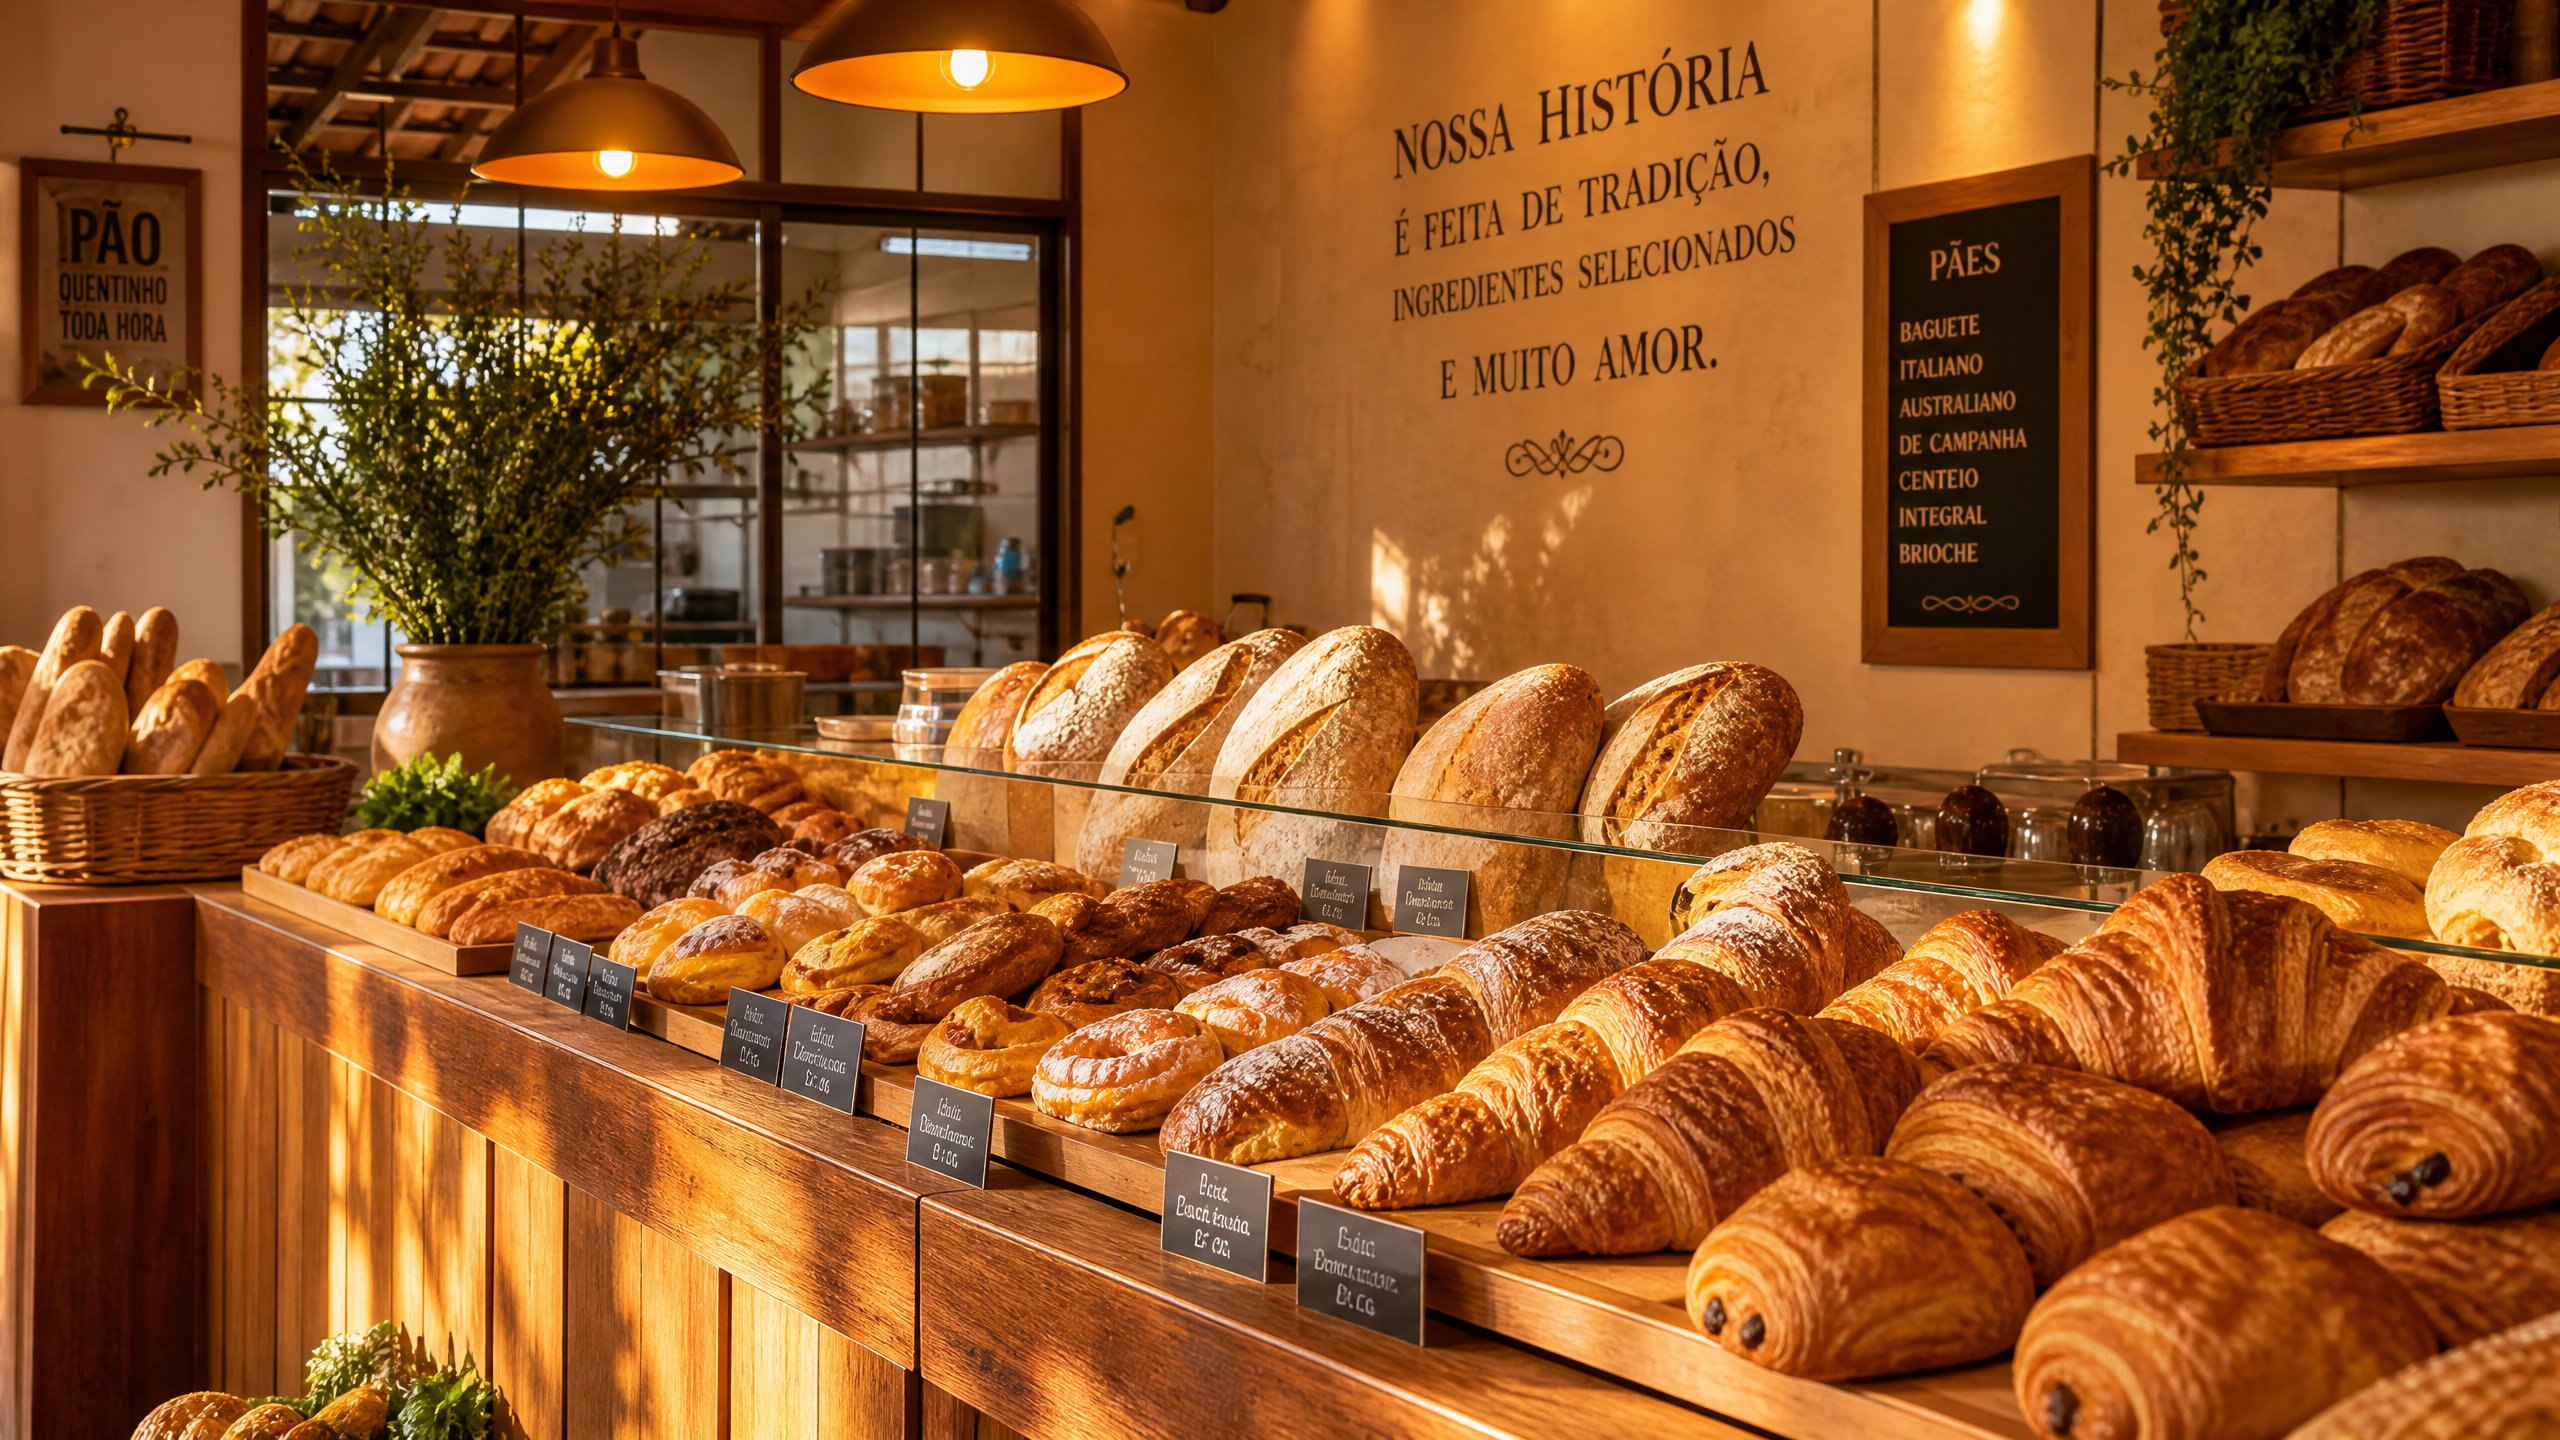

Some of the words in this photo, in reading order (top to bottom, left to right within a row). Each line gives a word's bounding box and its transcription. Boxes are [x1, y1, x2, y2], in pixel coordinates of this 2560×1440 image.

[1393, 103, 1515, 180] NOSSA
[1538, 40, 1770, 145] HISTÓRIA
[1394, 208, 1410, 257] É
[1424, 199, 1505, 251] FEITA
[1521, 185, 1564, 231] DE
[1579, 137, 1770, 218] TRADIÇÃO,
[71, 199, 160, 266] PÃO
[1393, 260, 1564, 323] INGREDIENTES
[1578, 215, 1796, 290] SELECIONADOS
[1930, 239, 2001, 281] PÃES
[59, 272, 167, 306] QUENTINHO
[59, 310, 109, 341] TODA
[116, 312, 167, 343] HORA
[1900, 314, 1980, 343] BAGUETE
[1440, 359, 1457, 399] E
[1473, 343, 1576, 396] MUITO
[1594, 324, 1718, 382] AMOR.
[1900, 353, 1983, 381] ITALIANO
[1899, 390, 2016, 418] AUSTRALIANO
[1899, 434, 1922, 455] DE
[1929, 428, 2027, 454] CAMPANHA
[1899, 468, 1979, 491] CENTEIO
[1899, 505, 1987, 528] INTEGRAL
[1899, 542, 1978, 564] BRIOCHE
